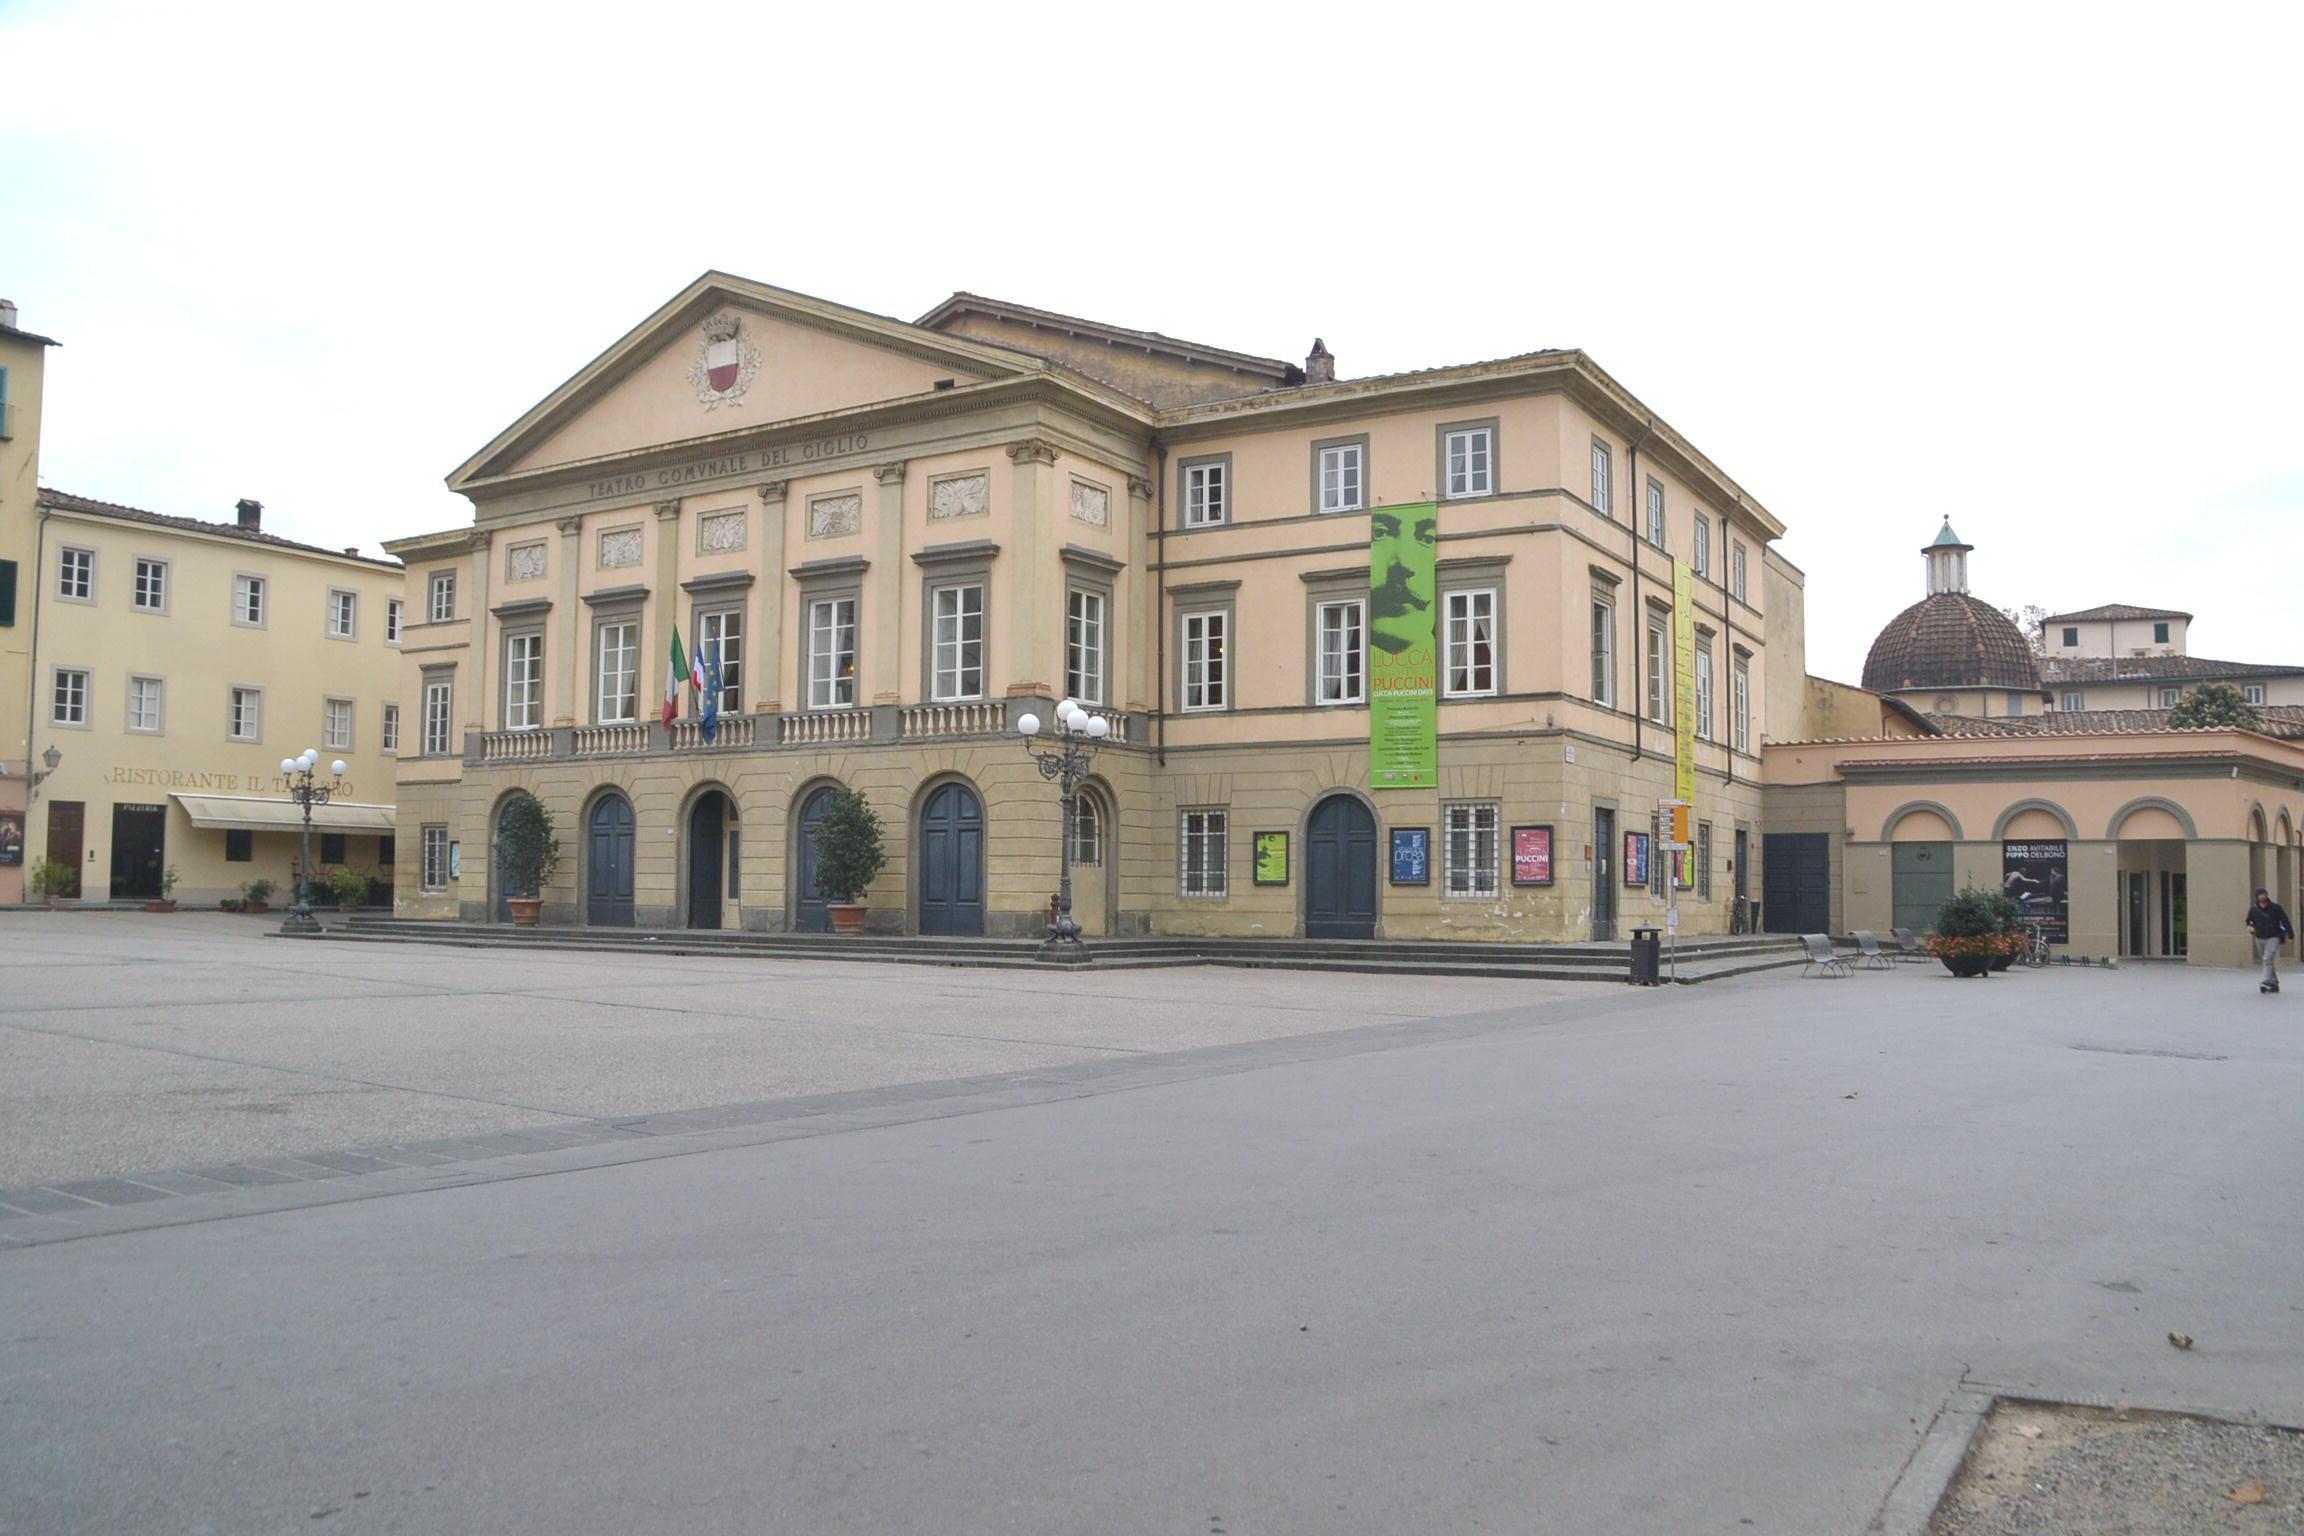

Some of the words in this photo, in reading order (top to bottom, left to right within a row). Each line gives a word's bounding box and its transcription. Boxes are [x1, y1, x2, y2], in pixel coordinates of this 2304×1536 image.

[589, 476, 645, 498] TEATRO
[658, 456, 748, 485] COMVNALE
[761, 448, 790, 467] DEL
[803, 434, 868, 458] GIGLIO
[1373, 649, 1433, 667] LUCCA
[1373, 675, 1434, 690] PUCCINI
[1373, 689, 1393, 697] LUCCA
[112, 767, 238, 790] RISTORANTE
[247, 775, 265, 790] IL
[1515, 854, 1548, 862] PUCCINI
